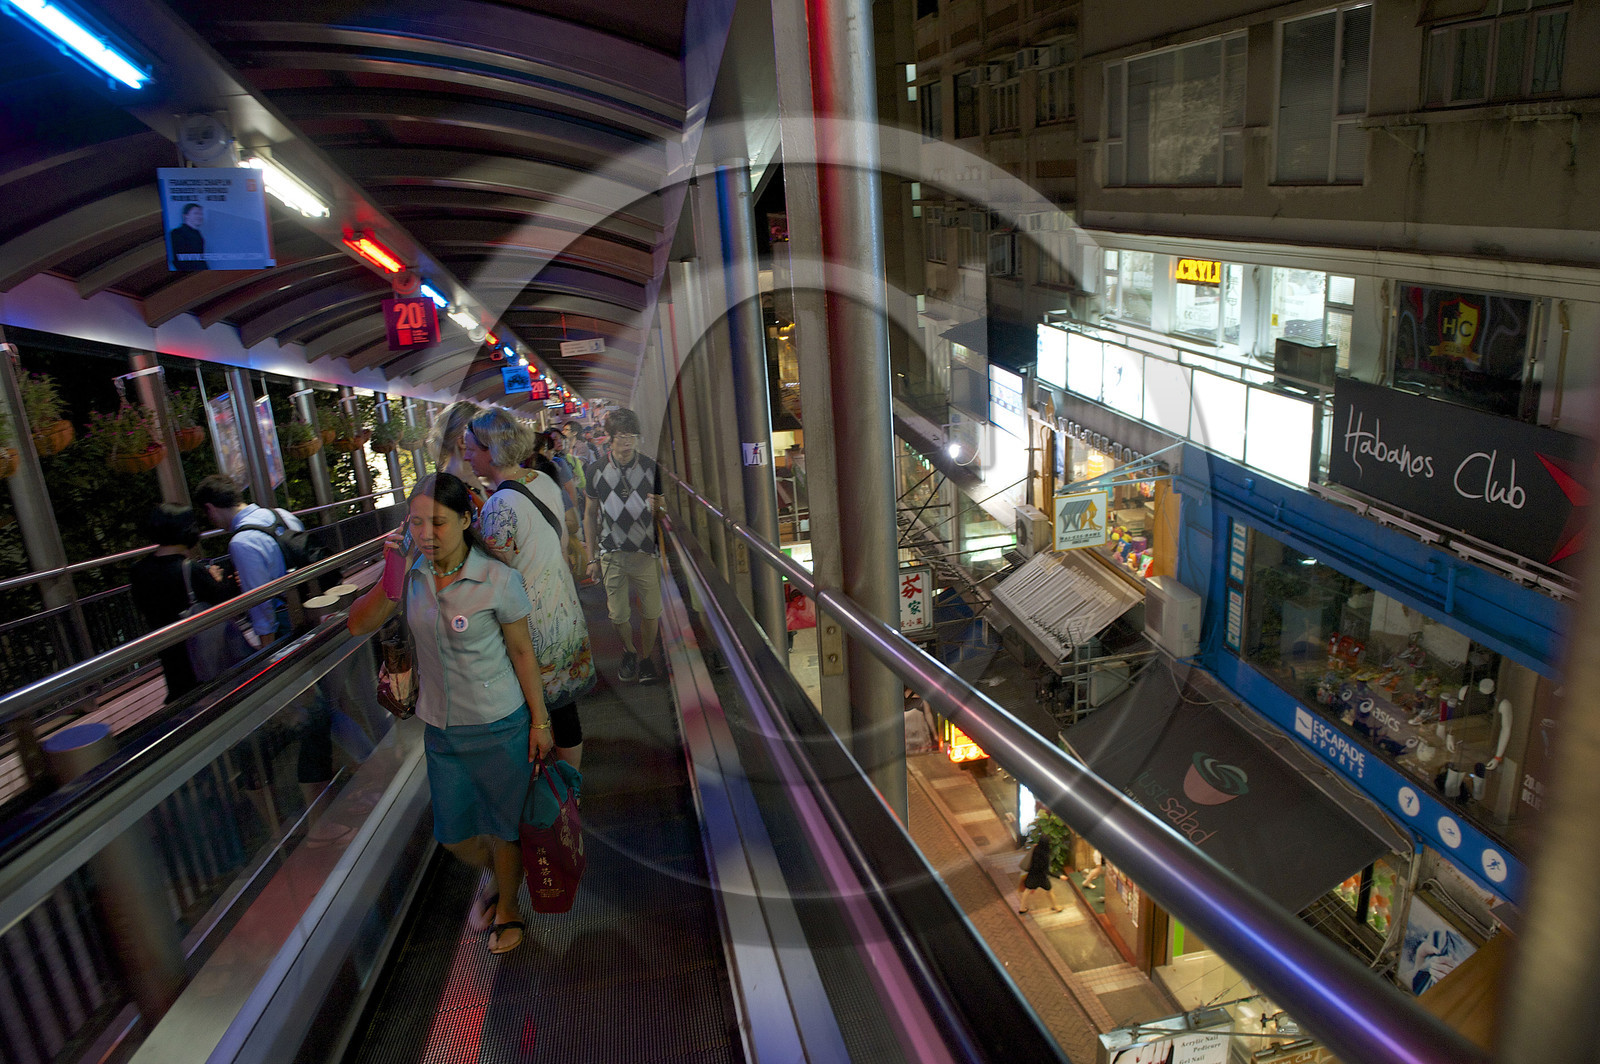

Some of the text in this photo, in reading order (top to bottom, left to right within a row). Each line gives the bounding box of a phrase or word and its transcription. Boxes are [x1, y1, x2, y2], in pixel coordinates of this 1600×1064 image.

[1175, 258, 1223, 284] CRYLI
[393, 302, 424, 329] 20
[1442, 317, 1473, 338] HC
[1344, 404, 1527, 510] Habanos Club
[1373, 707, 1401, 733] asics
[1312, 734, 1364, 779] SPORTS
[1313, 719, 1366, 768] ESCAPADE
[1159, 797, 1219, 846] salad
[1181, 1034, 1219, 1048] Acrylic Nail
[1193, 1042, 1222, 1053] Pedicure
[1192, 1055, 1206, 1063] Nail
